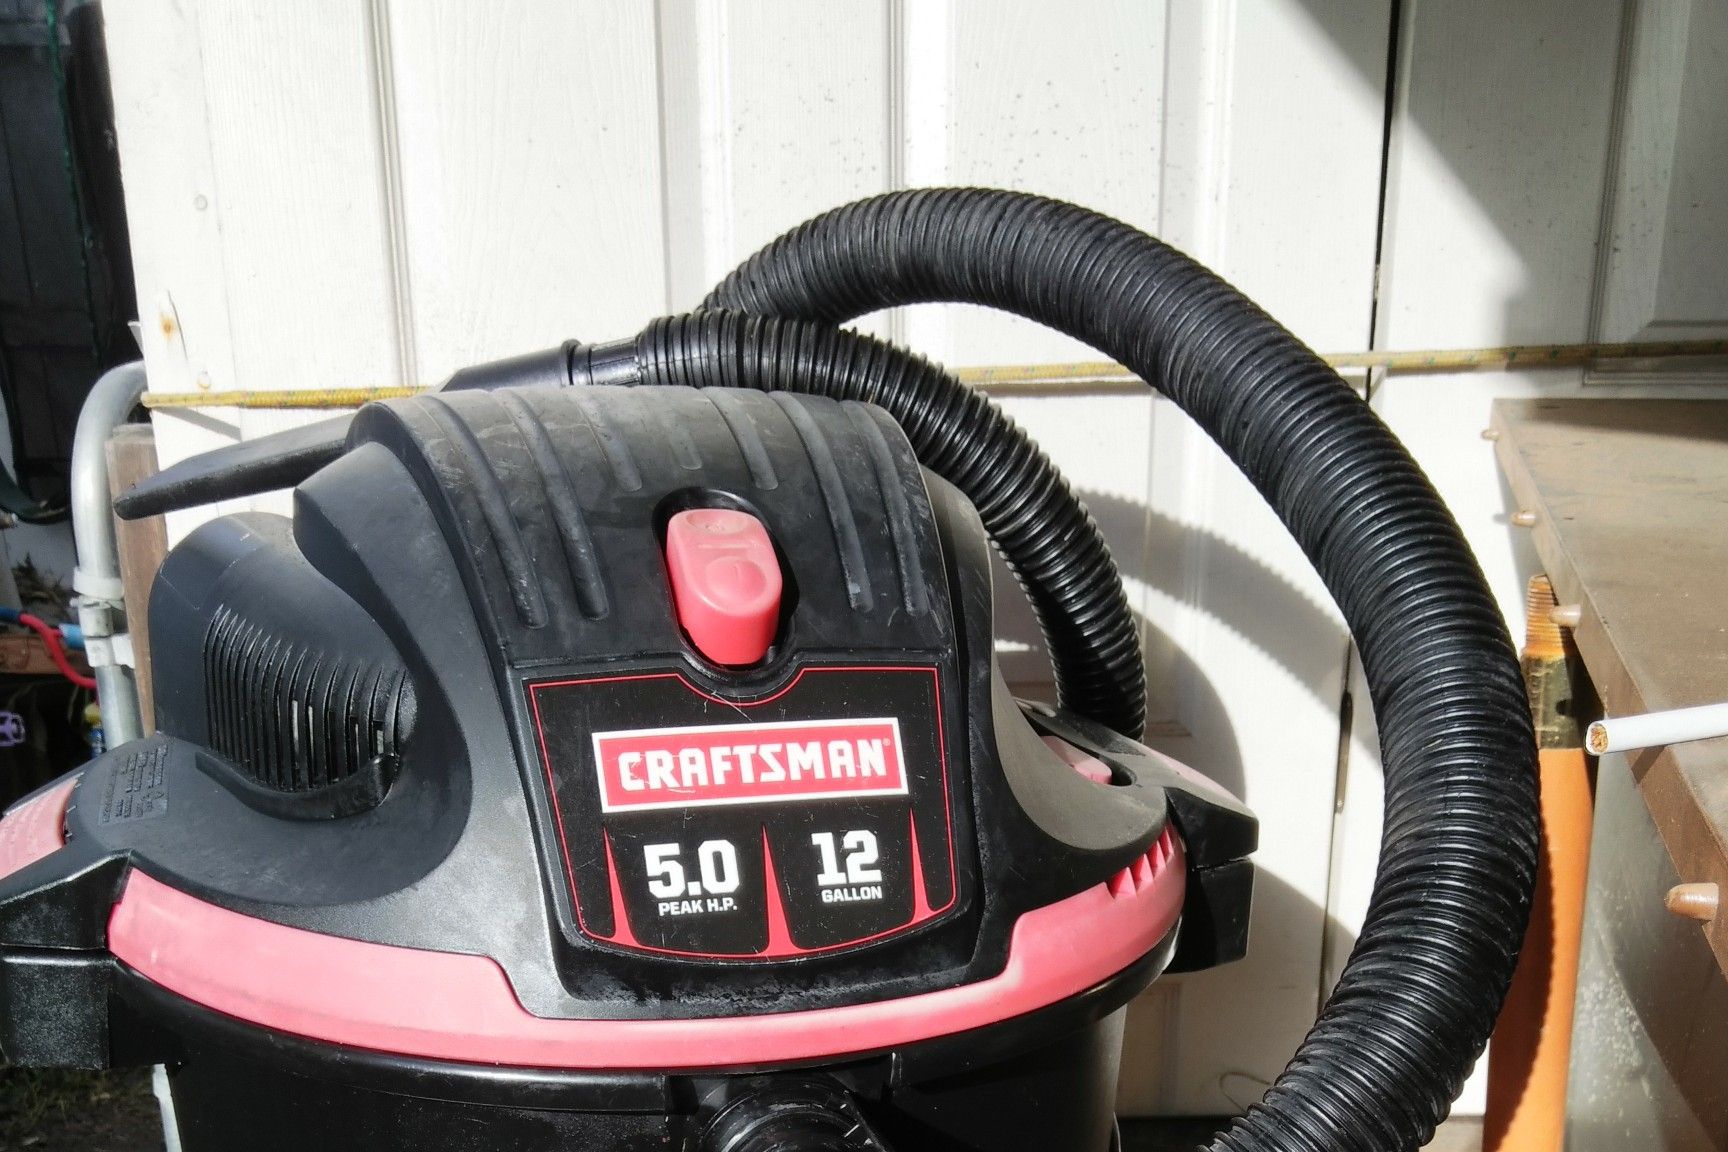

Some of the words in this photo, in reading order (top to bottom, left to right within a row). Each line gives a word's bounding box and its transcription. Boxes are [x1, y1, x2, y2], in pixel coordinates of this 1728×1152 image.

[618, 738, 887, 791] CRAFTSMAN
[643, 840, 740, 898] 5.0
[811, 830, 882, 886] 12
[658, 900, 704, 916] PEAK
[706, 897, 738, 912] H.P.
[821, 885, 883, 903] GALLON
